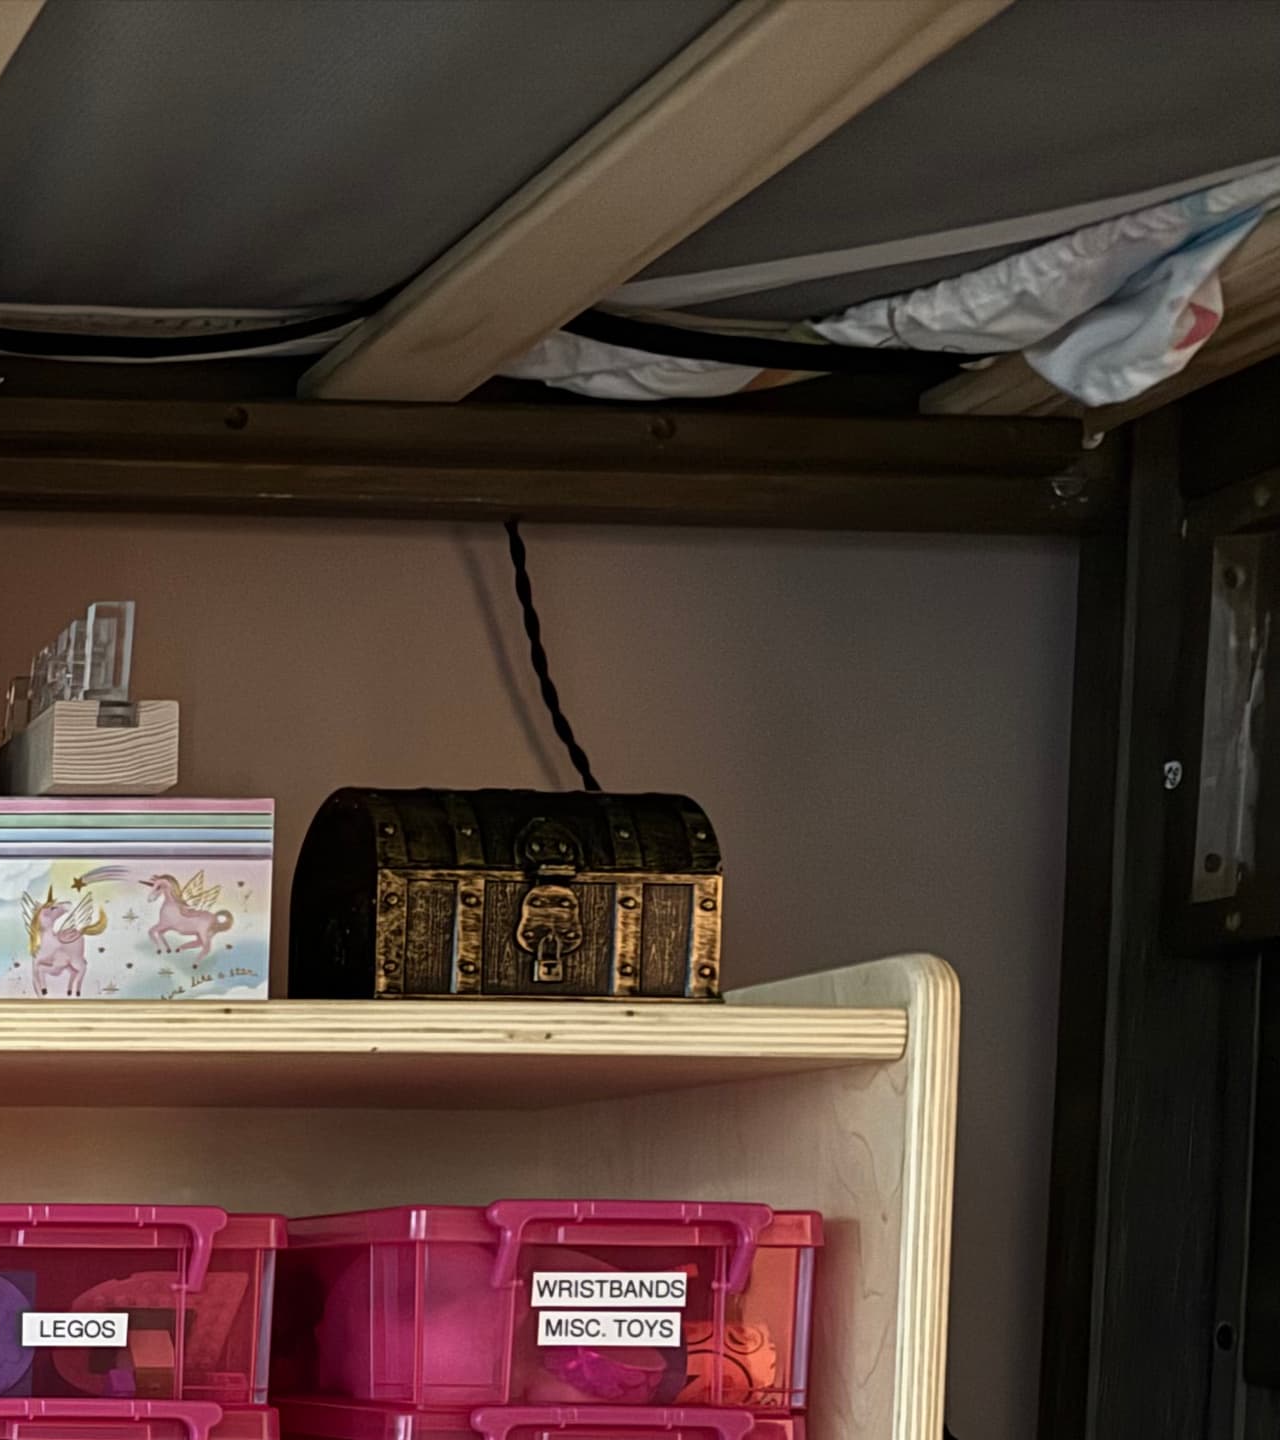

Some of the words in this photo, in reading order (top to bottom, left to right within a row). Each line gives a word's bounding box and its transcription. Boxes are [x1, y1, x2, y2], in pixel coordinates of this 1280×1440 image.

[537, 1279, 685, 1298] WRISTBANDS
[39, 1320, 116, 1338] LEGOS
[545, 1318, 606, 1338] MISC.
[614, 1319, 674, 1338] TOYS
